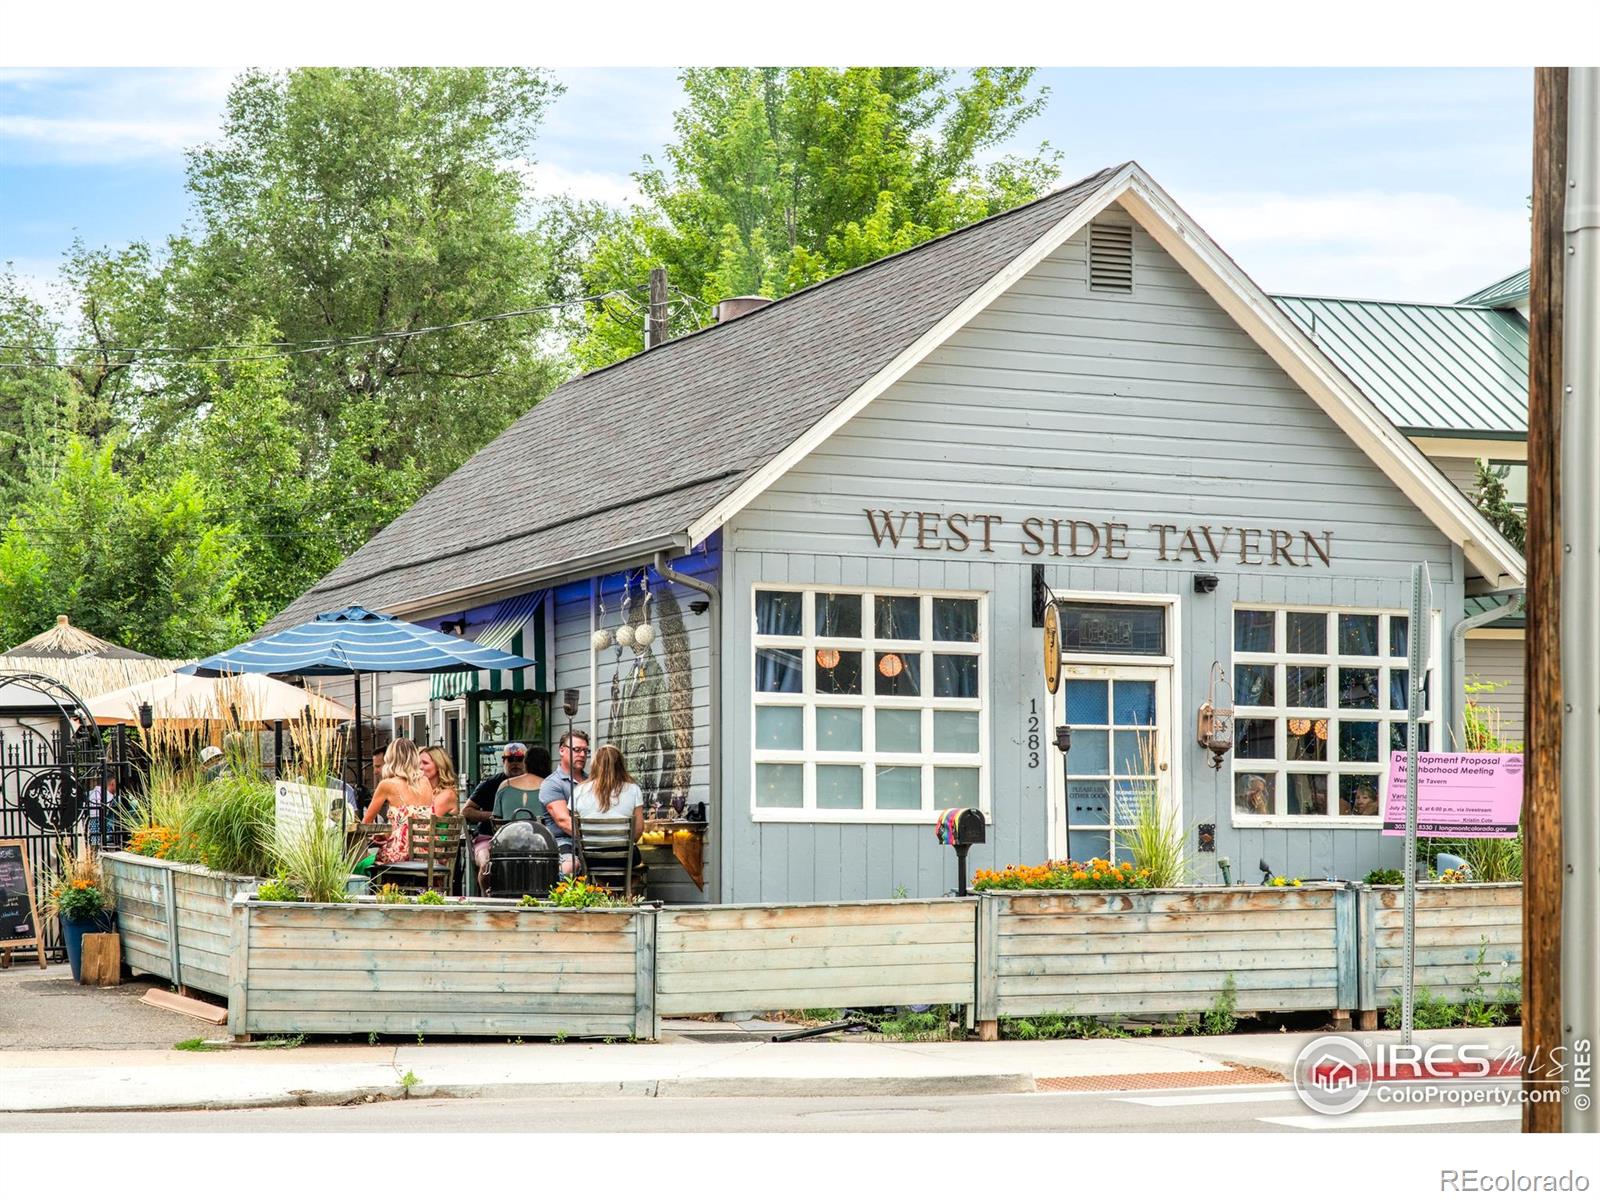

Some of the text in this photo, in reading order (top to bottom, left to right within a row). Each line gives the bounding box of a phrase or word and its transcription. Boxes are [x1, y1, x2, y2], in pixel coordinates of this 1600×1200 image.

[863, 508, 1334, 569] WEST SIDE TAVERN
[1028, 698, 1040, 768] 1283
[1395, 755, 1458, 765] Delopment
[1461, 756, 1501, 766] Proposal
[1398, 765, 1494, 776] Nhborhood Meeting
[1438, 825, 1507, 833] longmontcolorado.gov
